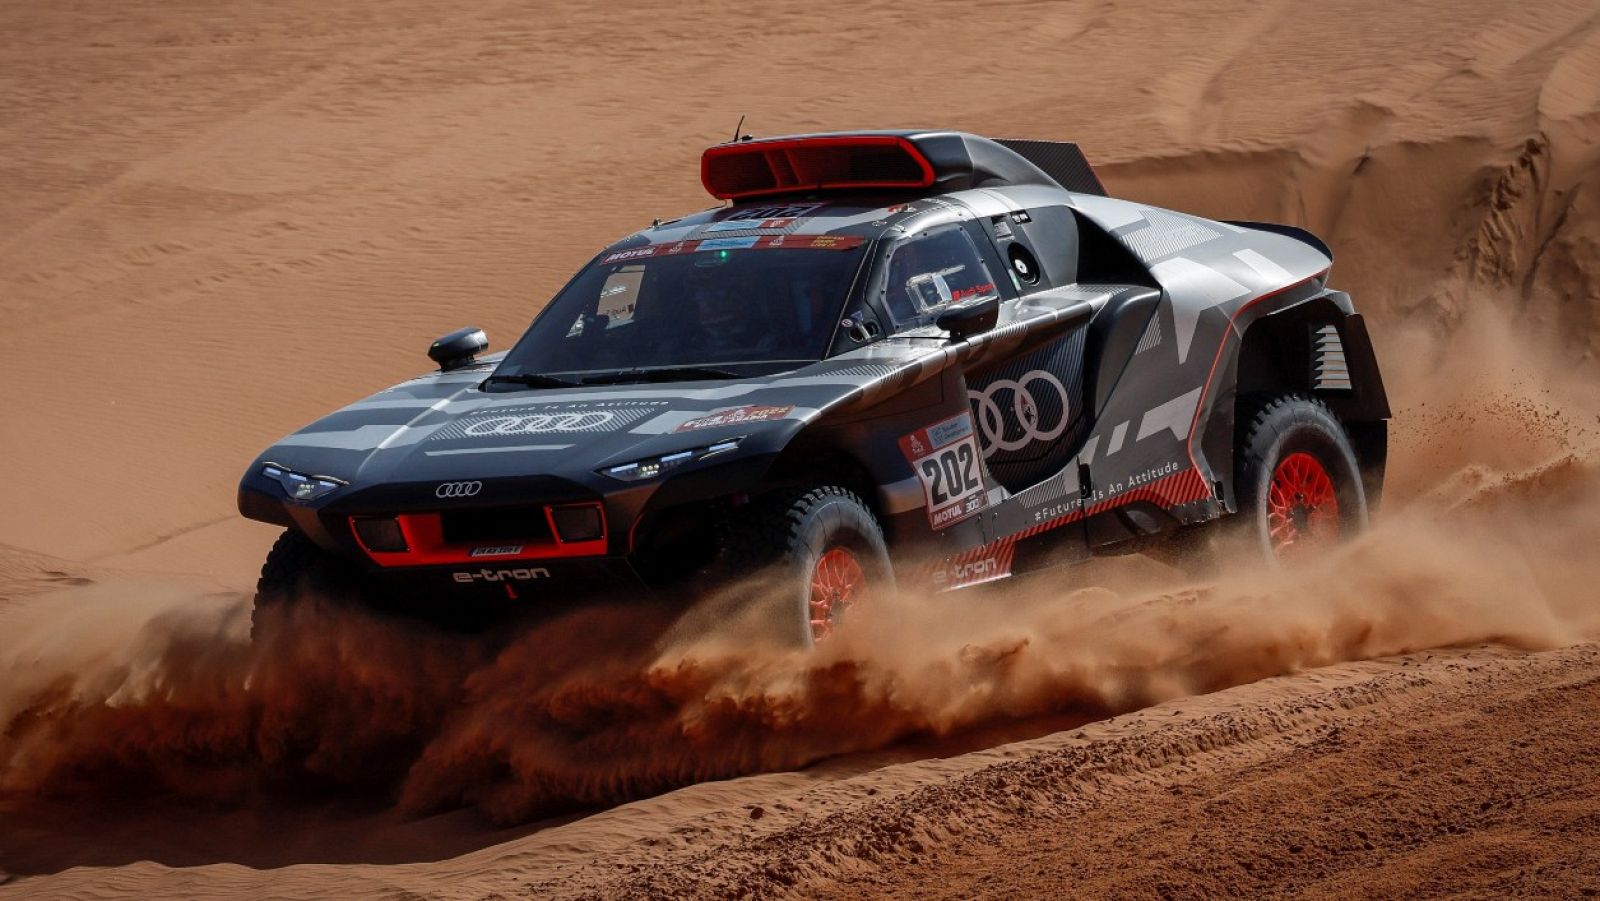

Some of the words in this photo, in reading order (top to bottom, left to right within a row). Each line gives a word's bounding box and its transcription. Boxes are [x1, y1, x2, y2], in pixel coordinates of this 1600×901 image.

[606, 247, 656, 261] MOTUL
[921, 443, 979, 506] 202
[1034, 498, 1083, 521] #Future
[1092, 489, 1104, 501] Is
[1108, 482, 1123, 495] An
[1127, 461, 1179, 486] Attitude
[932, 504, 963, 525] MOTUL
[452, 567, 551, 583] e-tron
